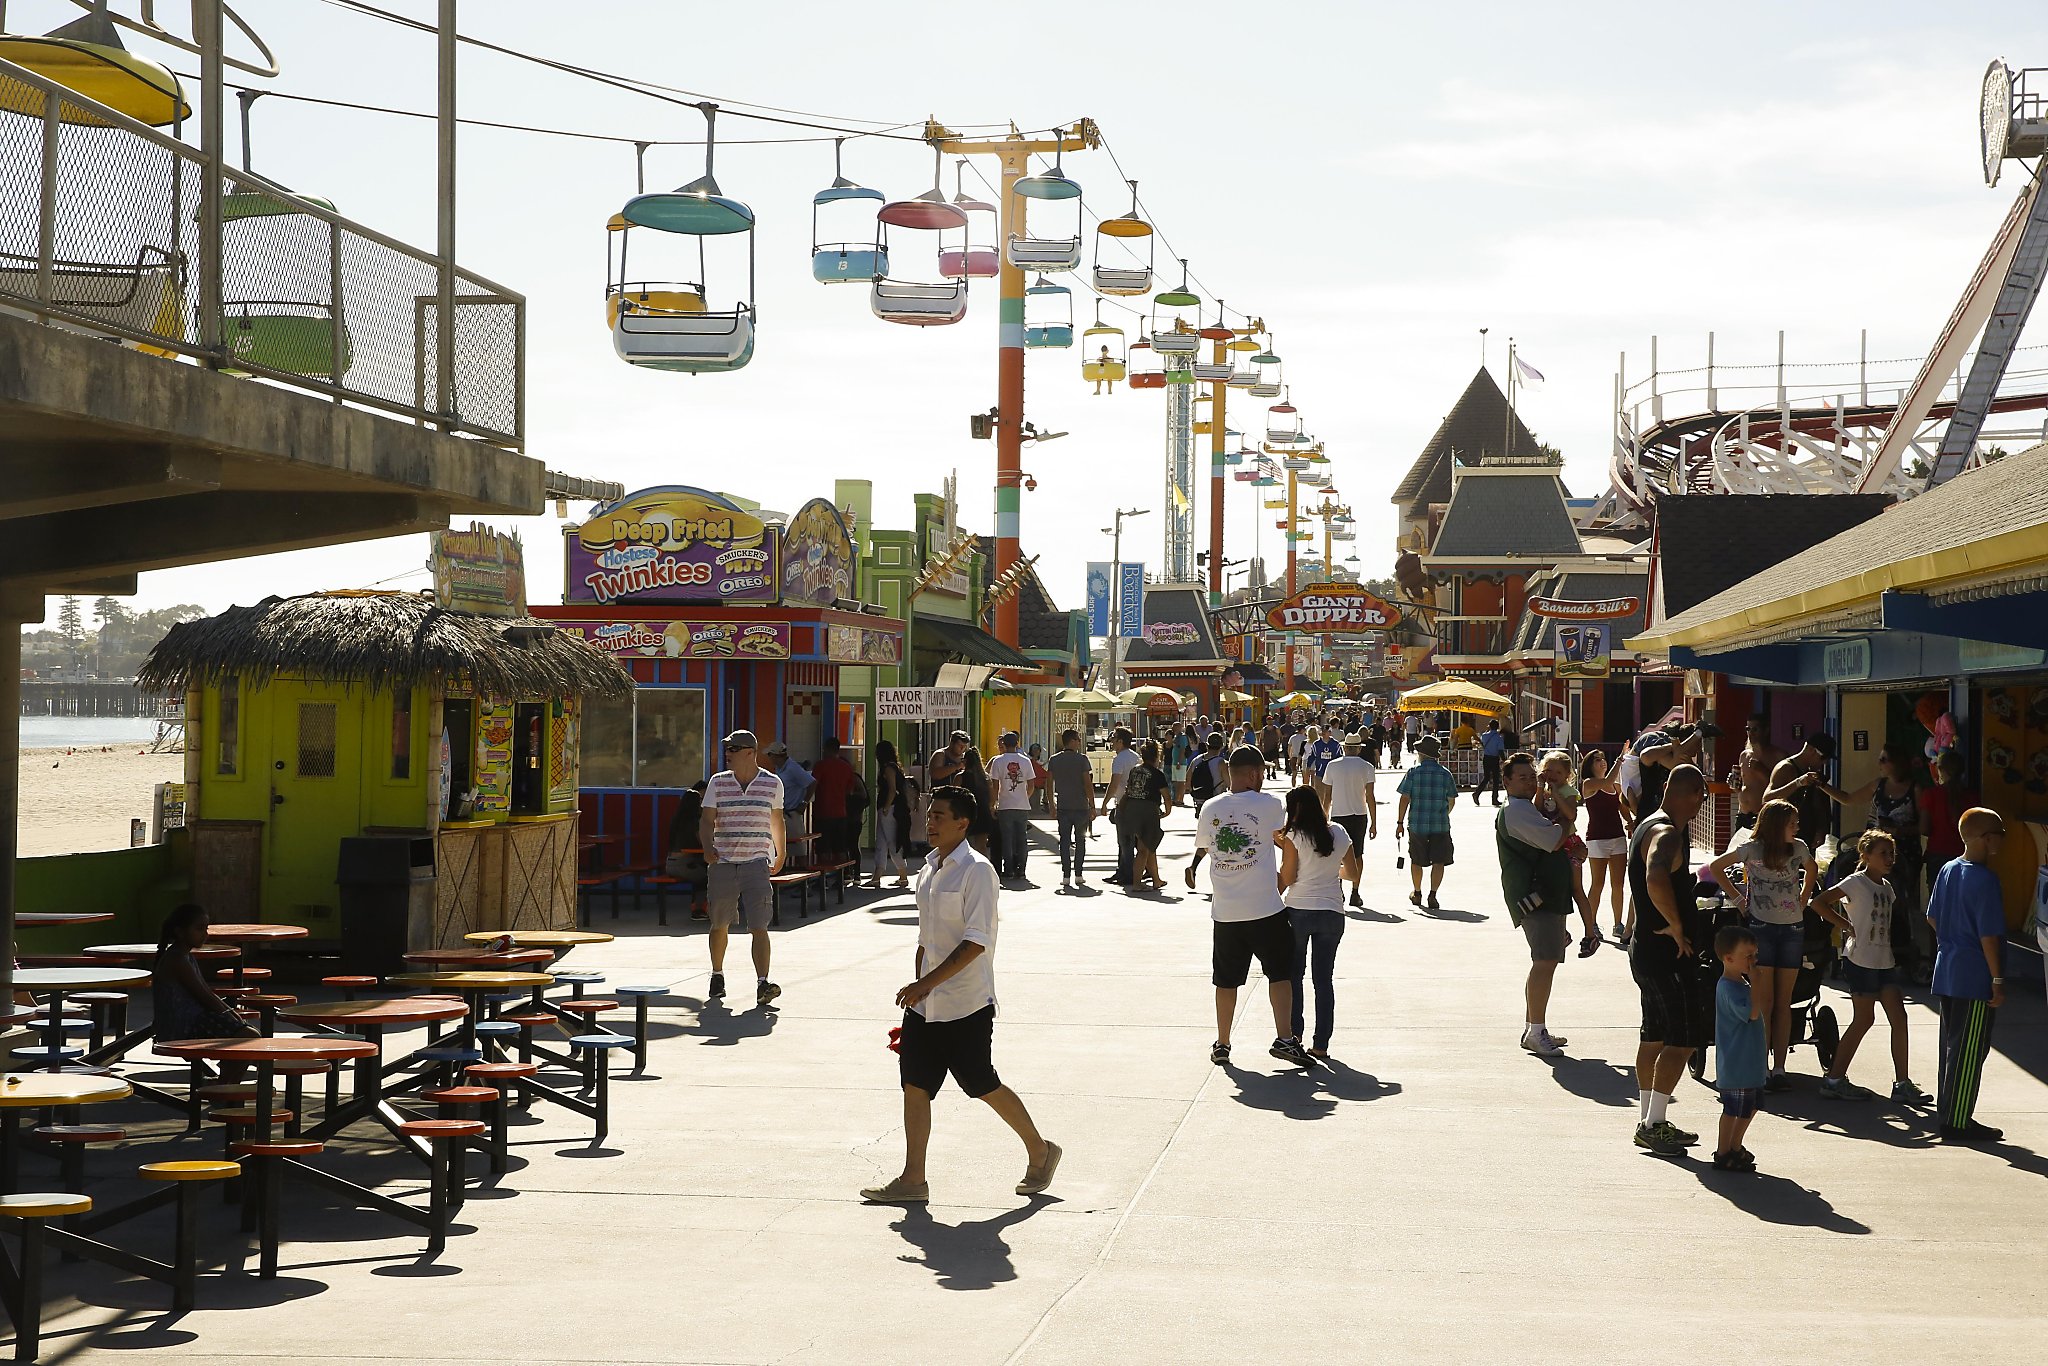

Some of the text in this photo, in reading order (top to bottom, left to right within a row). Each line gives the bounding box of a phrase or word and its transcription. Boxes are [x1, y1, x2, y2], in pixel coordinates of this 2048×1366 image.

[1009, 157, 1015, 165] 2
[838, 261, 848, 271] 13
[612, 518, 733, 545] Deep Fried
[603, 546, 657, 569] Hostess
[718, 550, 766, 564] SMUCKER'S
[587, 557, 712, 602] Twinkies
[1124, 564, 1140, 637] Boardwalk
[1302, 595, 1365, 608] GIANT
[1539, 600, 1630, 613] Barnacle Bill's
[1283, 607, 1386, 625] DIPPER
[599, 625, 631, 636] Hostess
[879, 690, 922, 702] FLAVOR
[928, 690, 963, 707] FLAVOR STATION
[879, 703, 922, 715] STATION
[1436, 697, 1458, 706] Face
[1460, 697, 1504, 713] Painting
